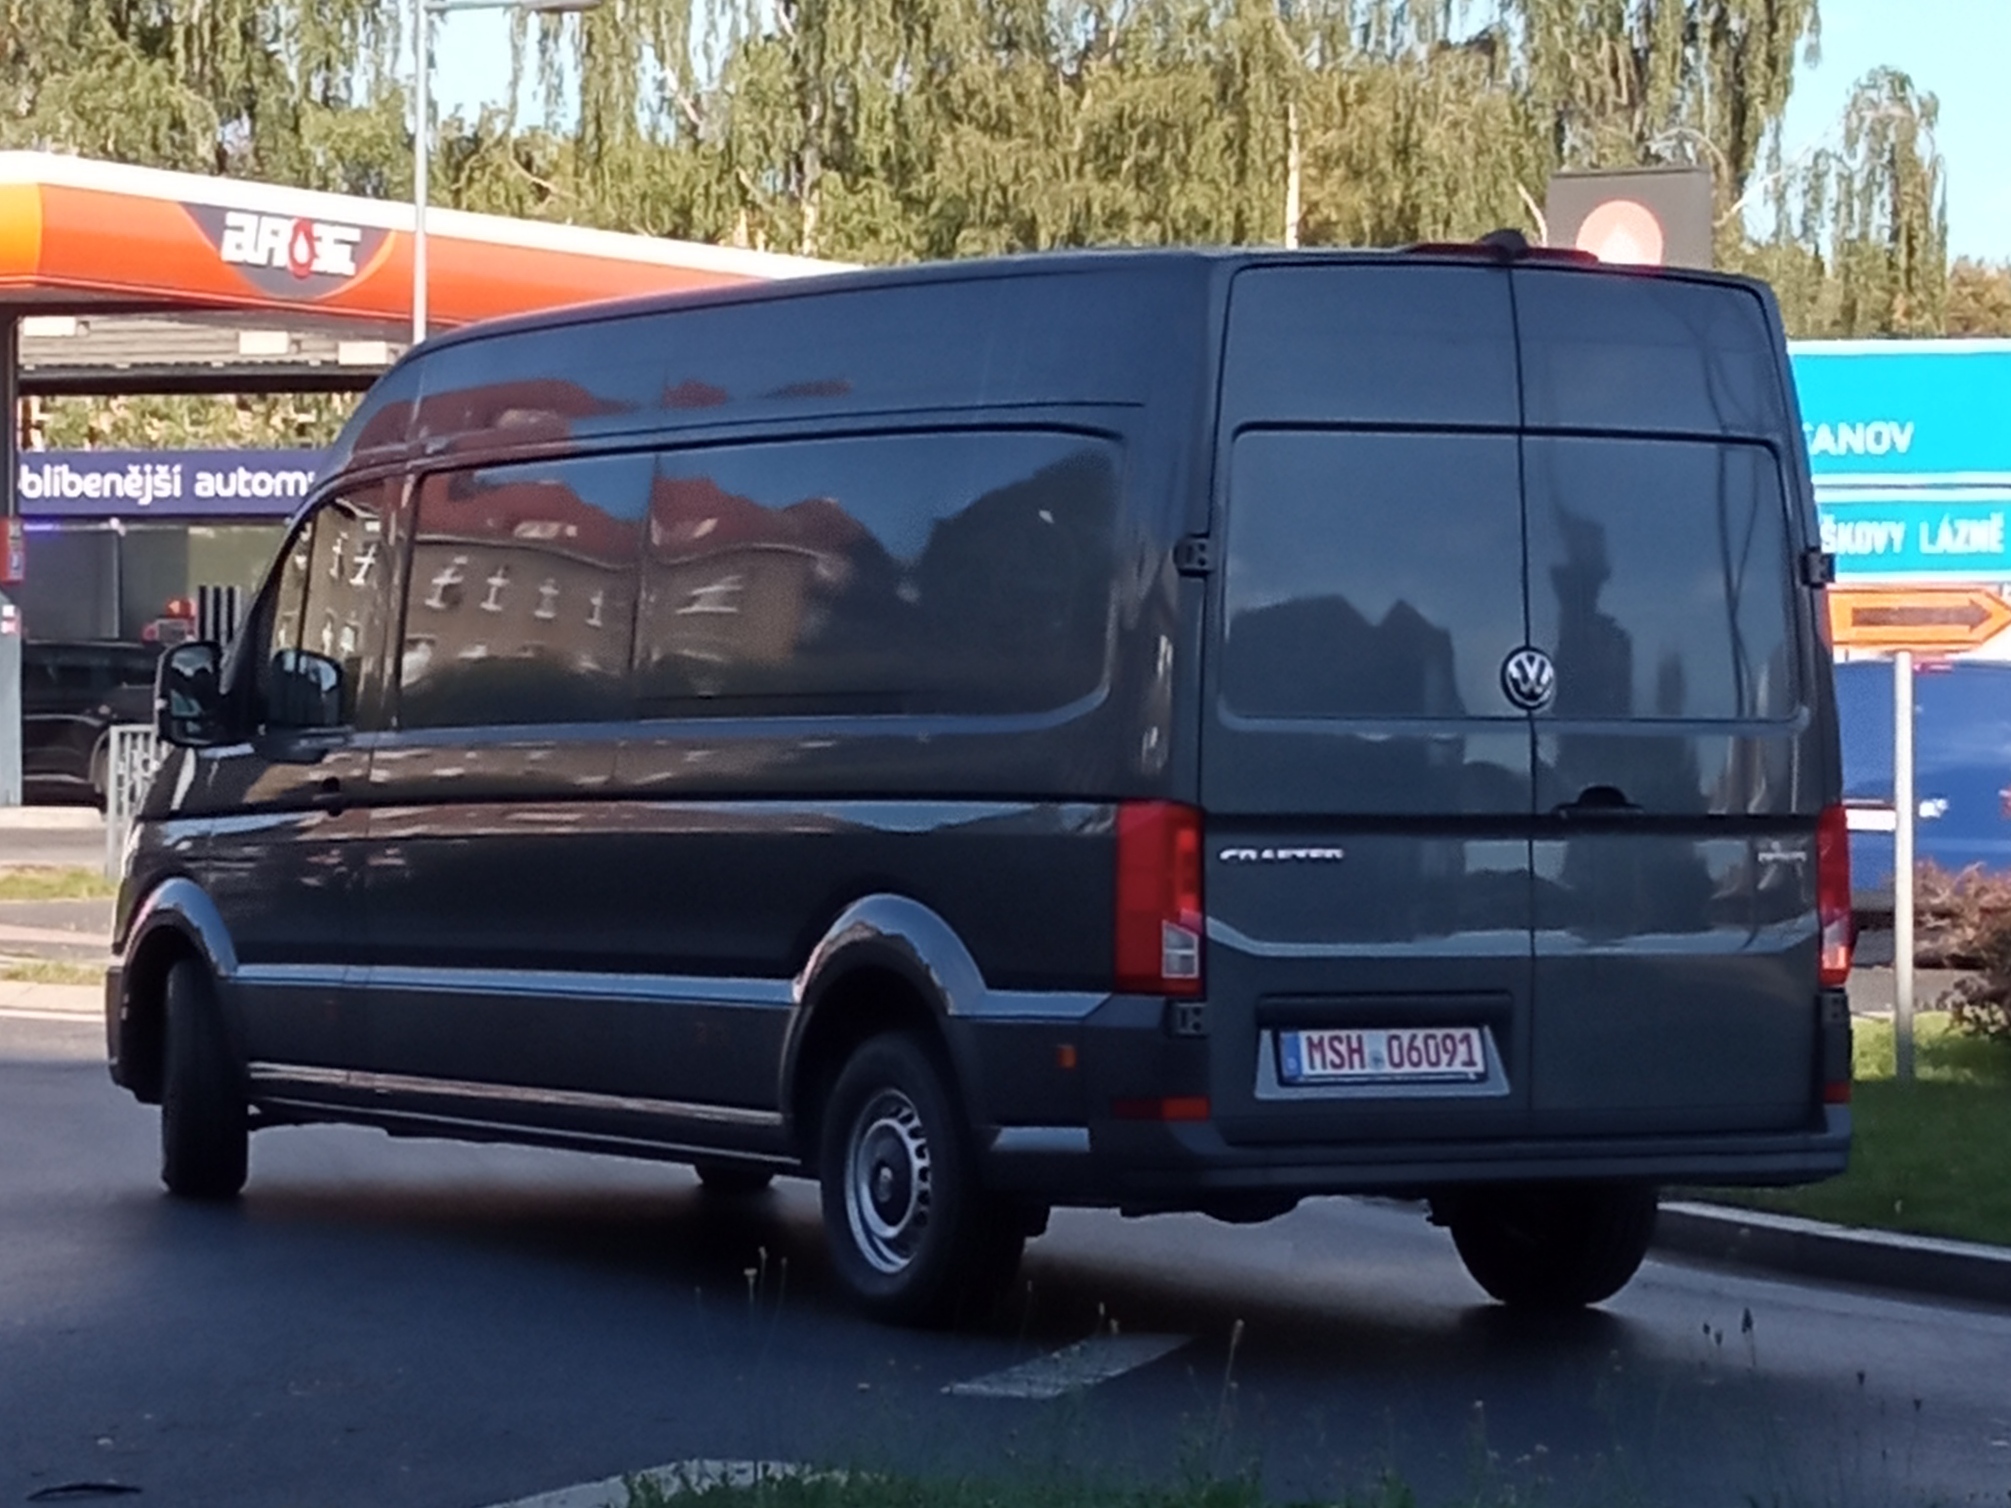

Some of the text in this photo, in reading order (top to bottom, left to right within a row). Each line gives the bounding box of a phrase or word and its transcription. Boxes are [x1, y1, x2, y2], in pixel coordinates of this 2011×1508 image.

[18, 463, 315, 505] blíbenější autom
[1919, 511, 2004, 554] LÁZNĚ
[1306, 1032, 1477, 1070] MSH 06091
